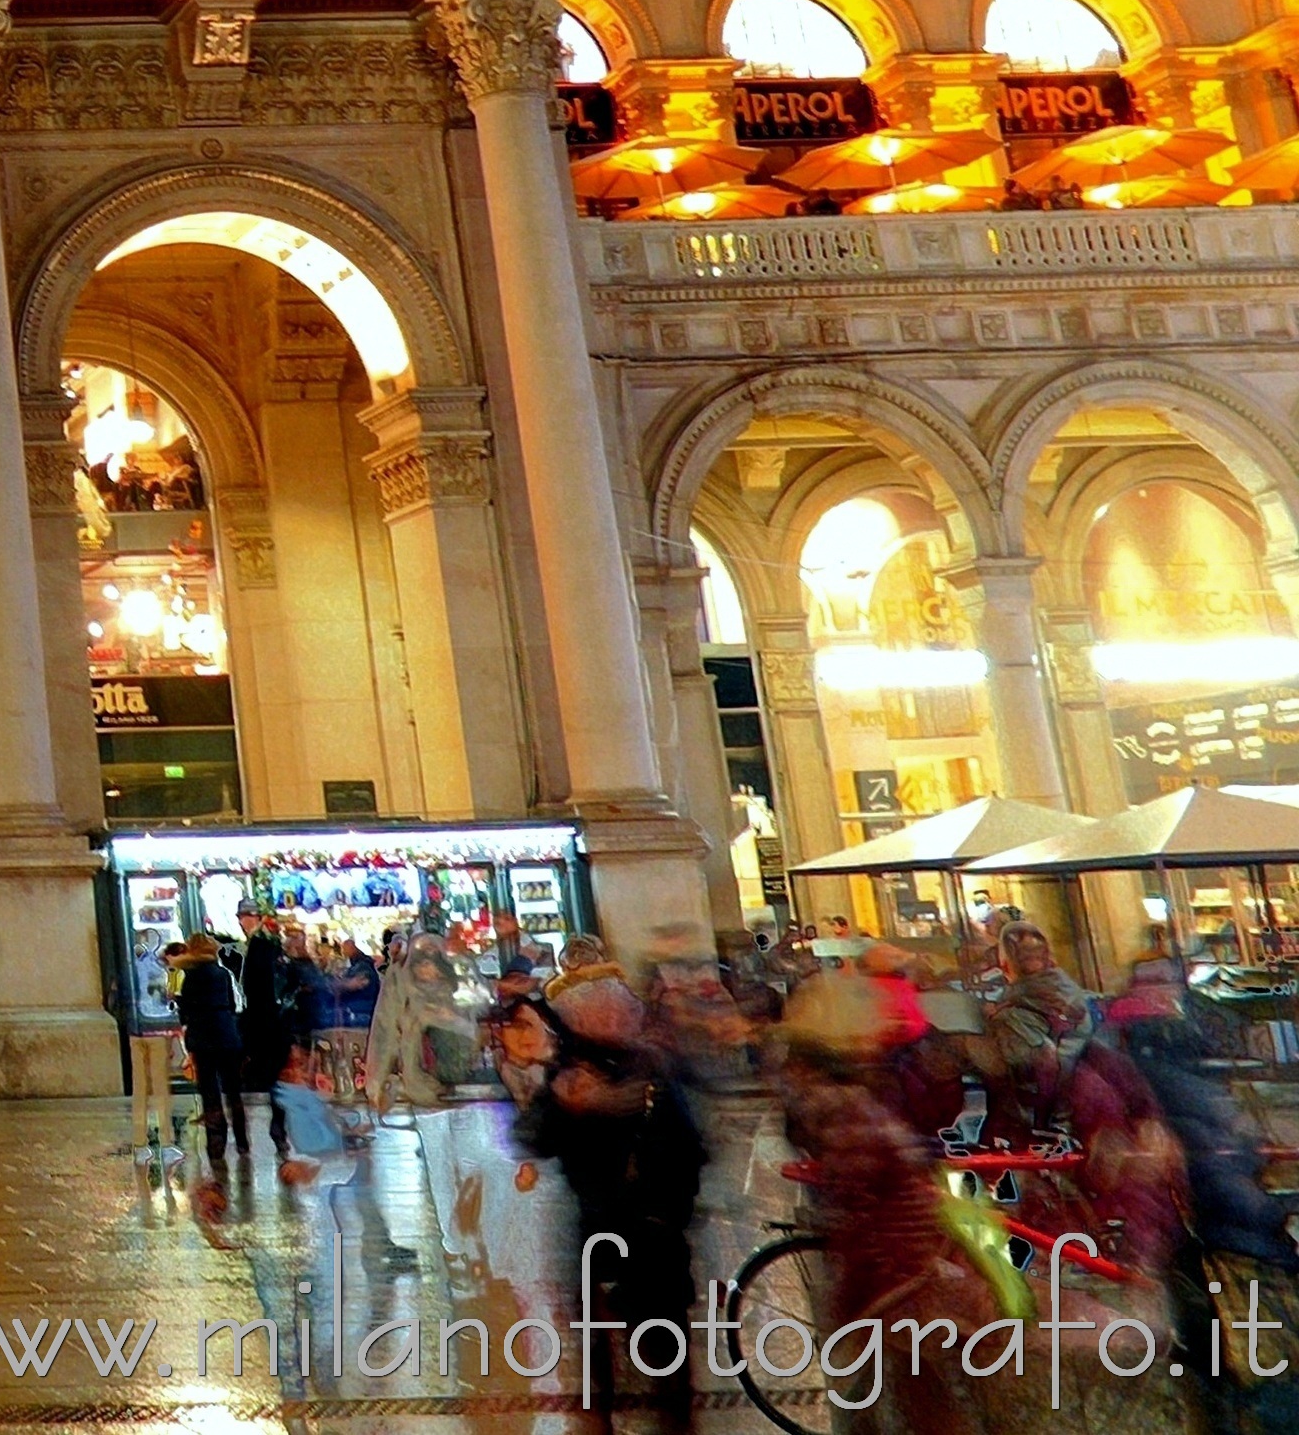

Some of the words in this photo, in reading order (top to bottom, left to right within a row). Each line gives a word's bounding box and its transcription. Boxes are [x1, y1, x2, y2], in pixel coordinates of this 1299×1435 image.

[734, 87, 856, 122] APEROL
[745, 122, 858, 137] ERRAZZA
[90, 682, 149, 715] otta
